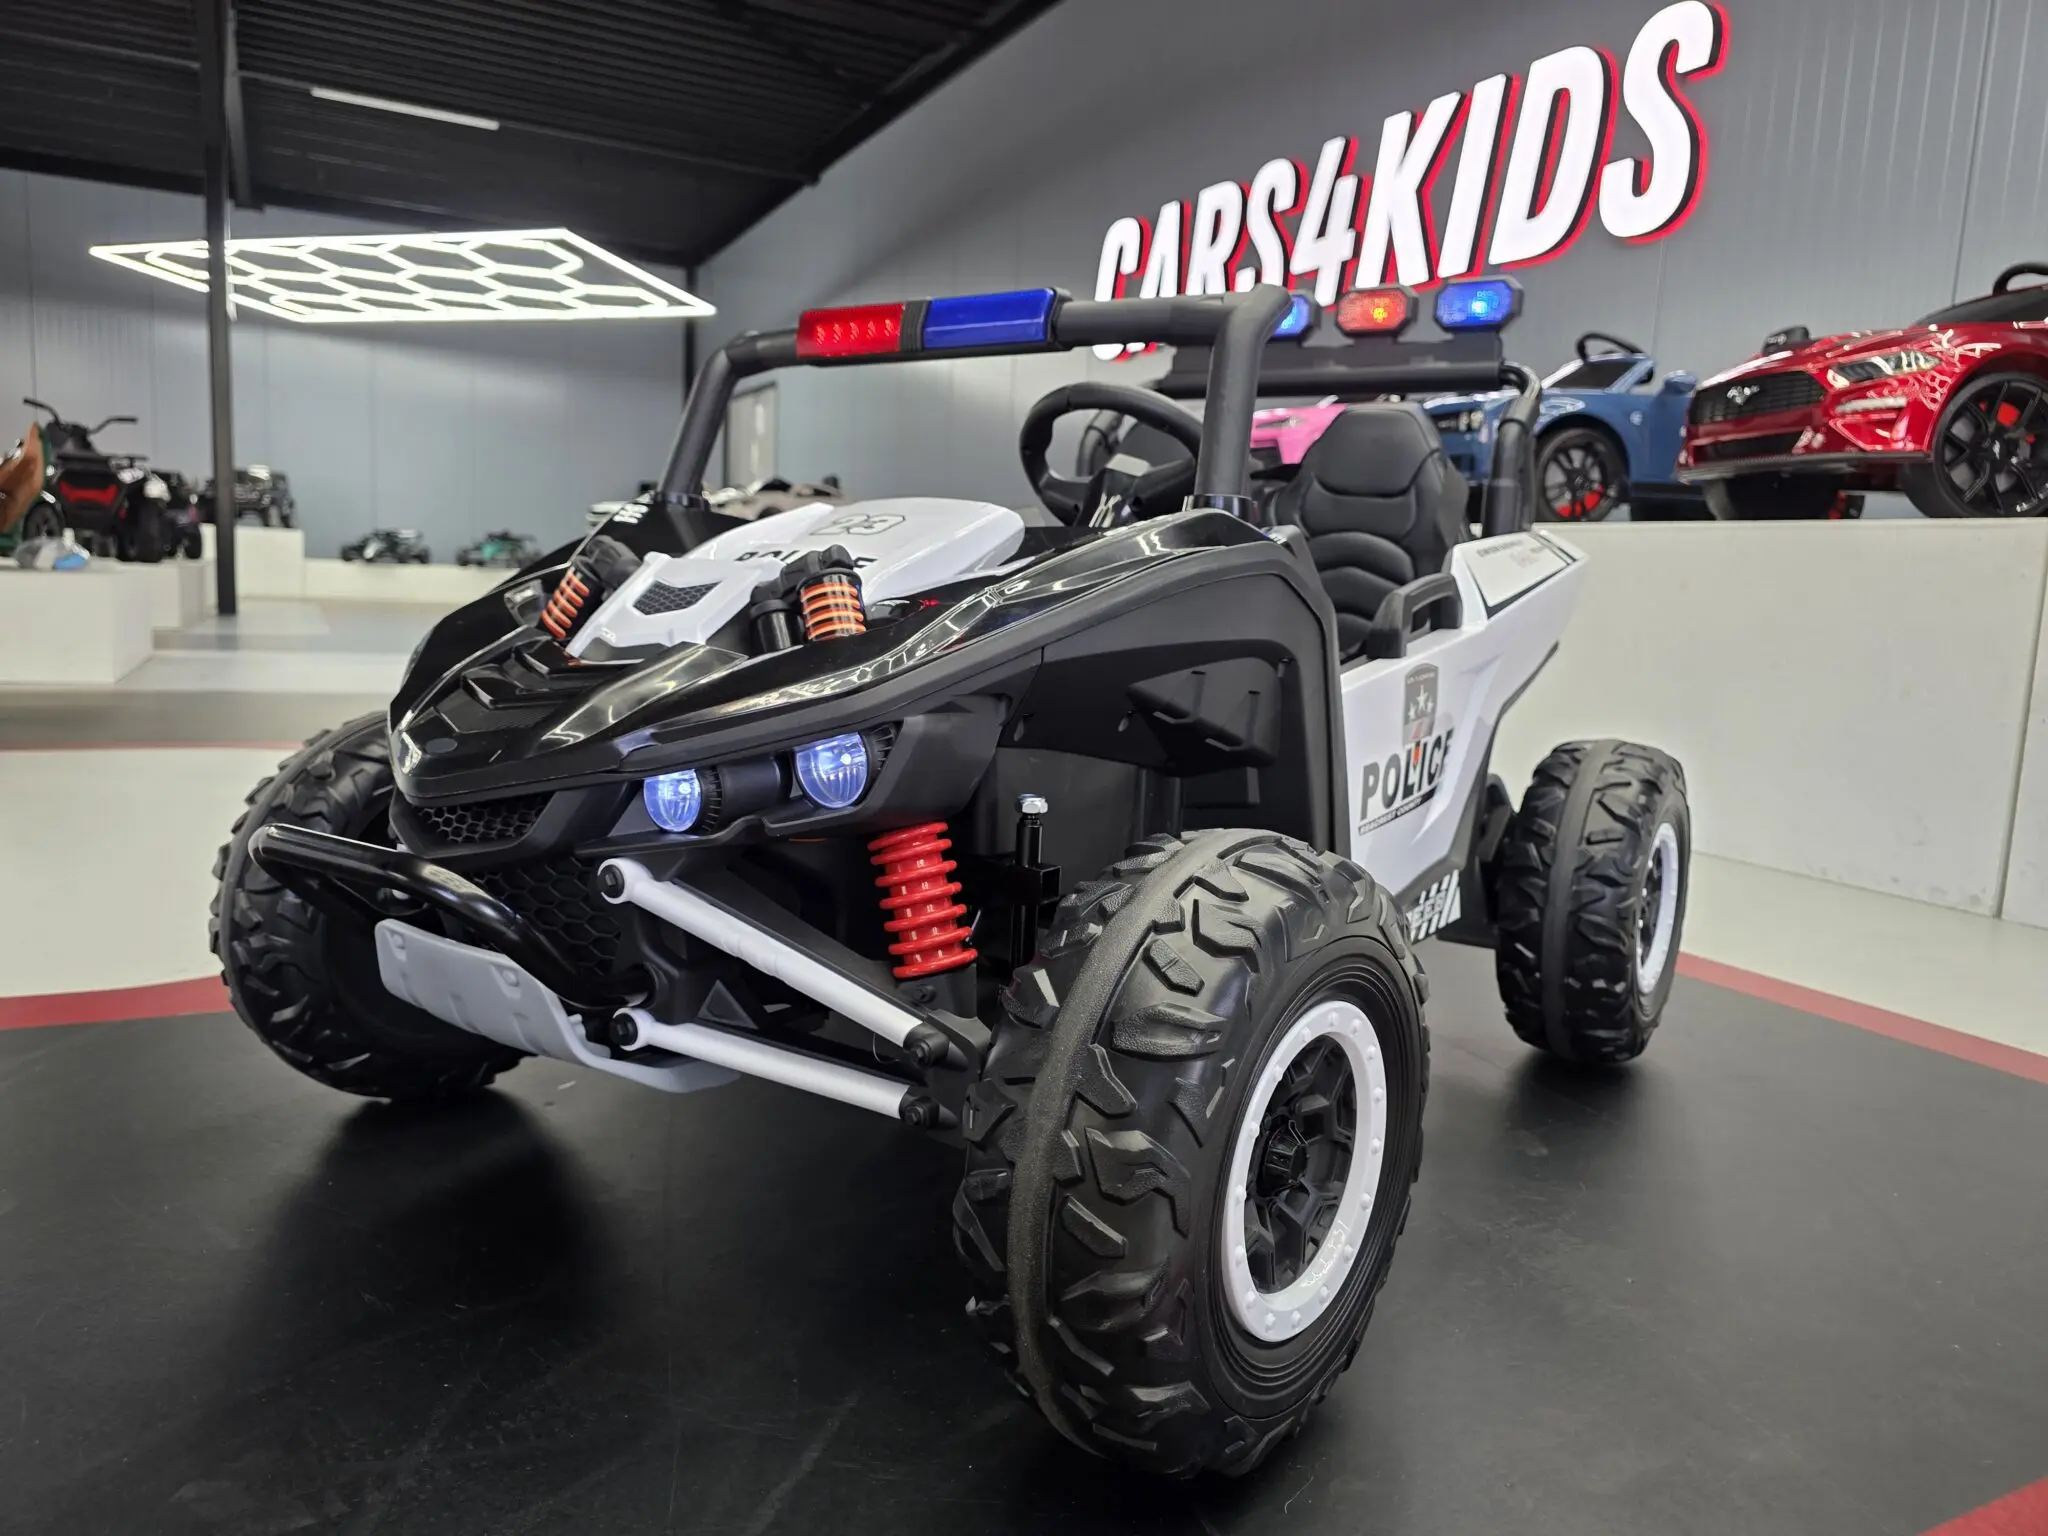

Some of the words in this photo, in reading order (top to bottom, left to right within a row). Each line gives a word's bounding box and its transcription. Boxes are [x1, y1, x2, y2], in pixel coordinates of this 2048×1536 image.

[1093, 0, 1722, 361] CARS4KIDS
[809, 513, 906, 536] 23
[1359, 726, 1456, 822] POLICE
